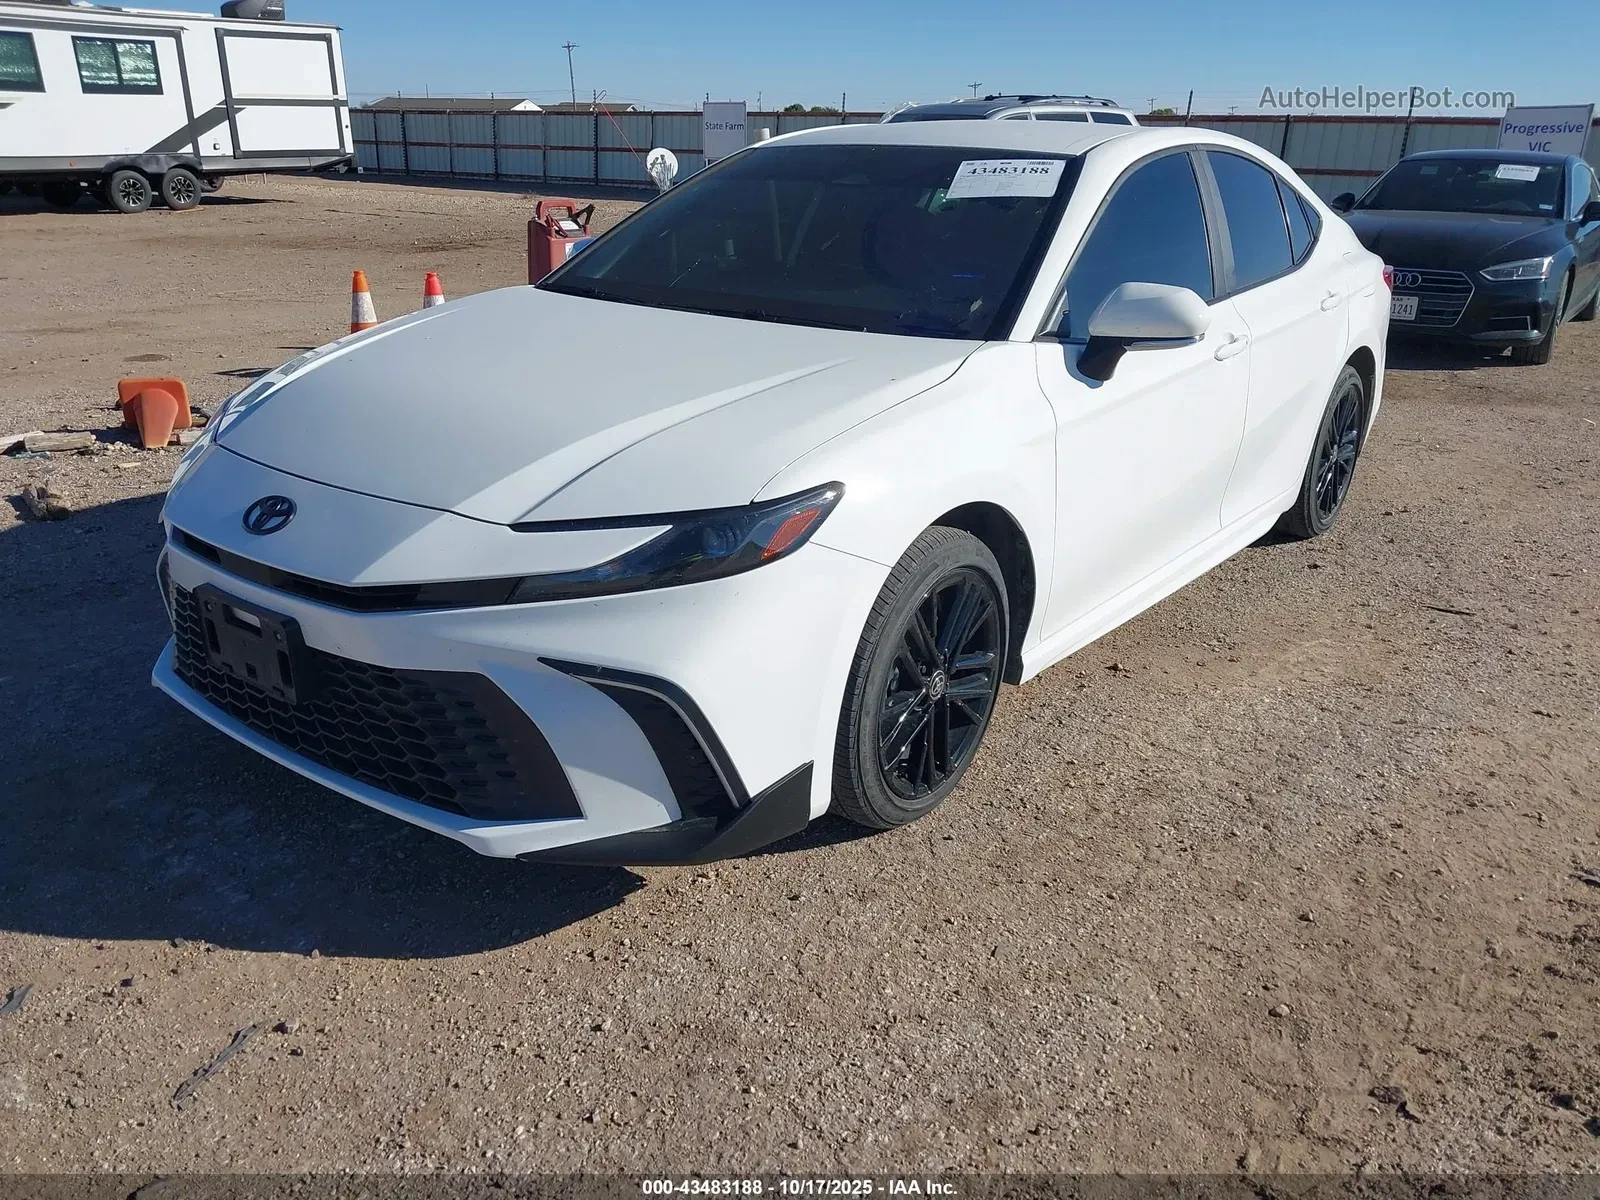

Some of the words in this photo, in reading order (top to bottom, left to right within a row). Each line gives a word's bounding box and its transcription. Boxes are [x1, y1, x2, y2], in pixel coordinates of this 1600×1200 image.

[705, 121, 723, 130] State
[725, 122, 744, 131] Farm
[1504, 121, 1584, 136] Progressive
[1528, 141, 1552, 152] VIC
[967, 166, 1050, 175] 43483188
